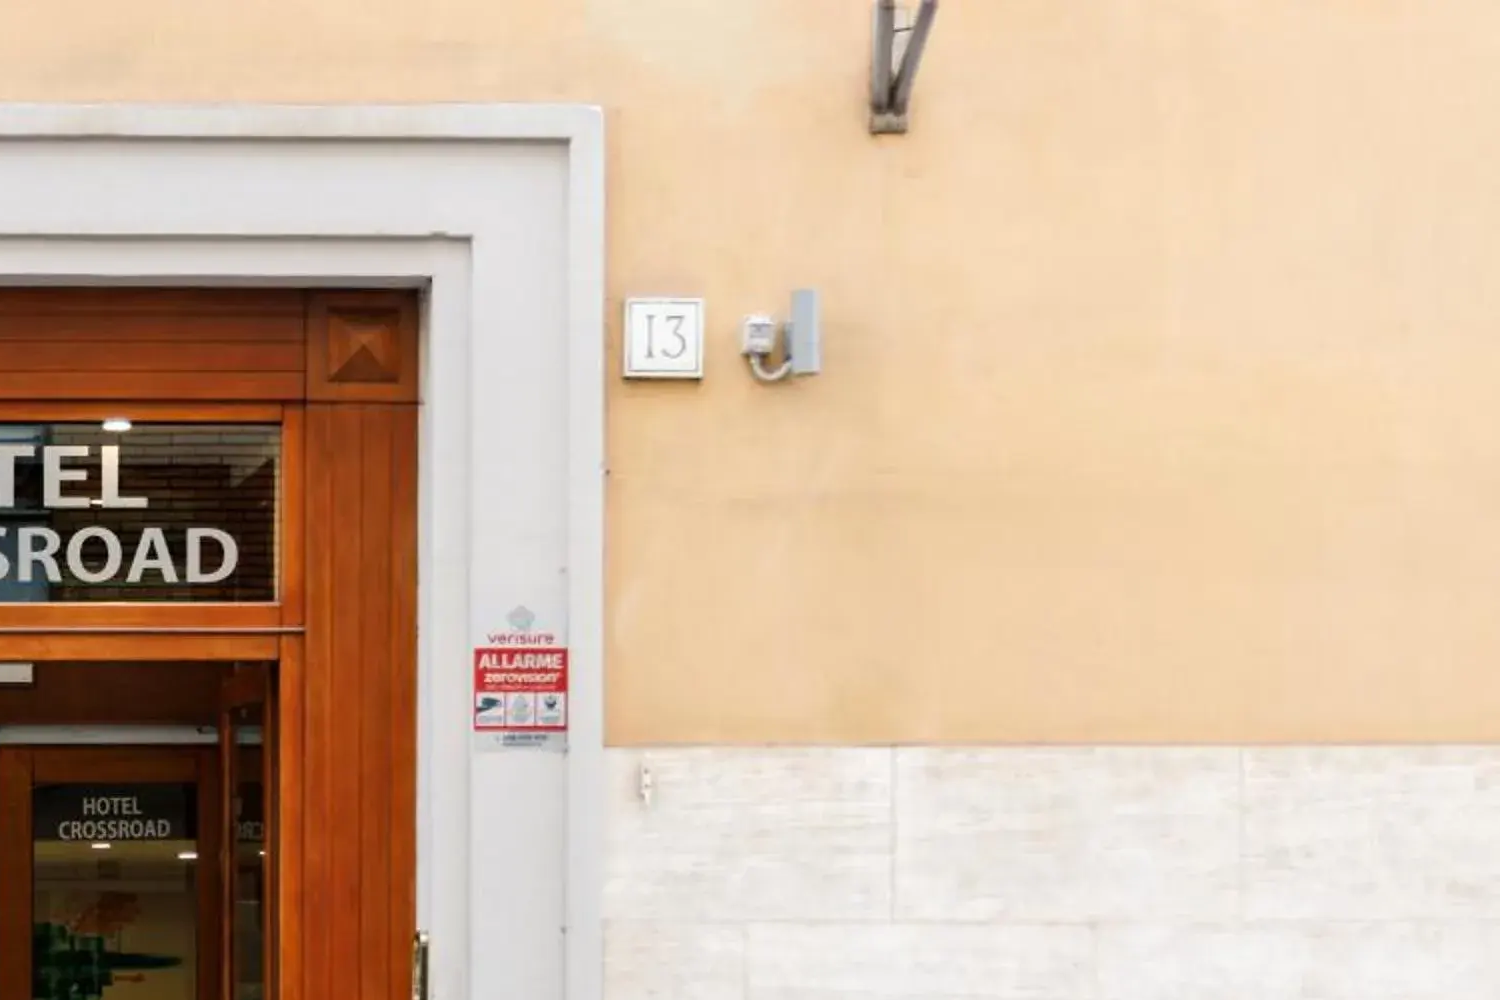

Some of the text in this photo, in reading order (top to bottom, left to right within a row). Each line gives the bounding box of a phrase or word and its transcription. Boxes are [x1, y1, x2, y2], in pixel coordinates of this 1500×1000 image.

[645, 314, 687, 360] 13
[479, 652, 564, 670] ALLARME
[83, 797, 143, 816] HOTEL
[58, 819, 171, 840] CROSSROAD
